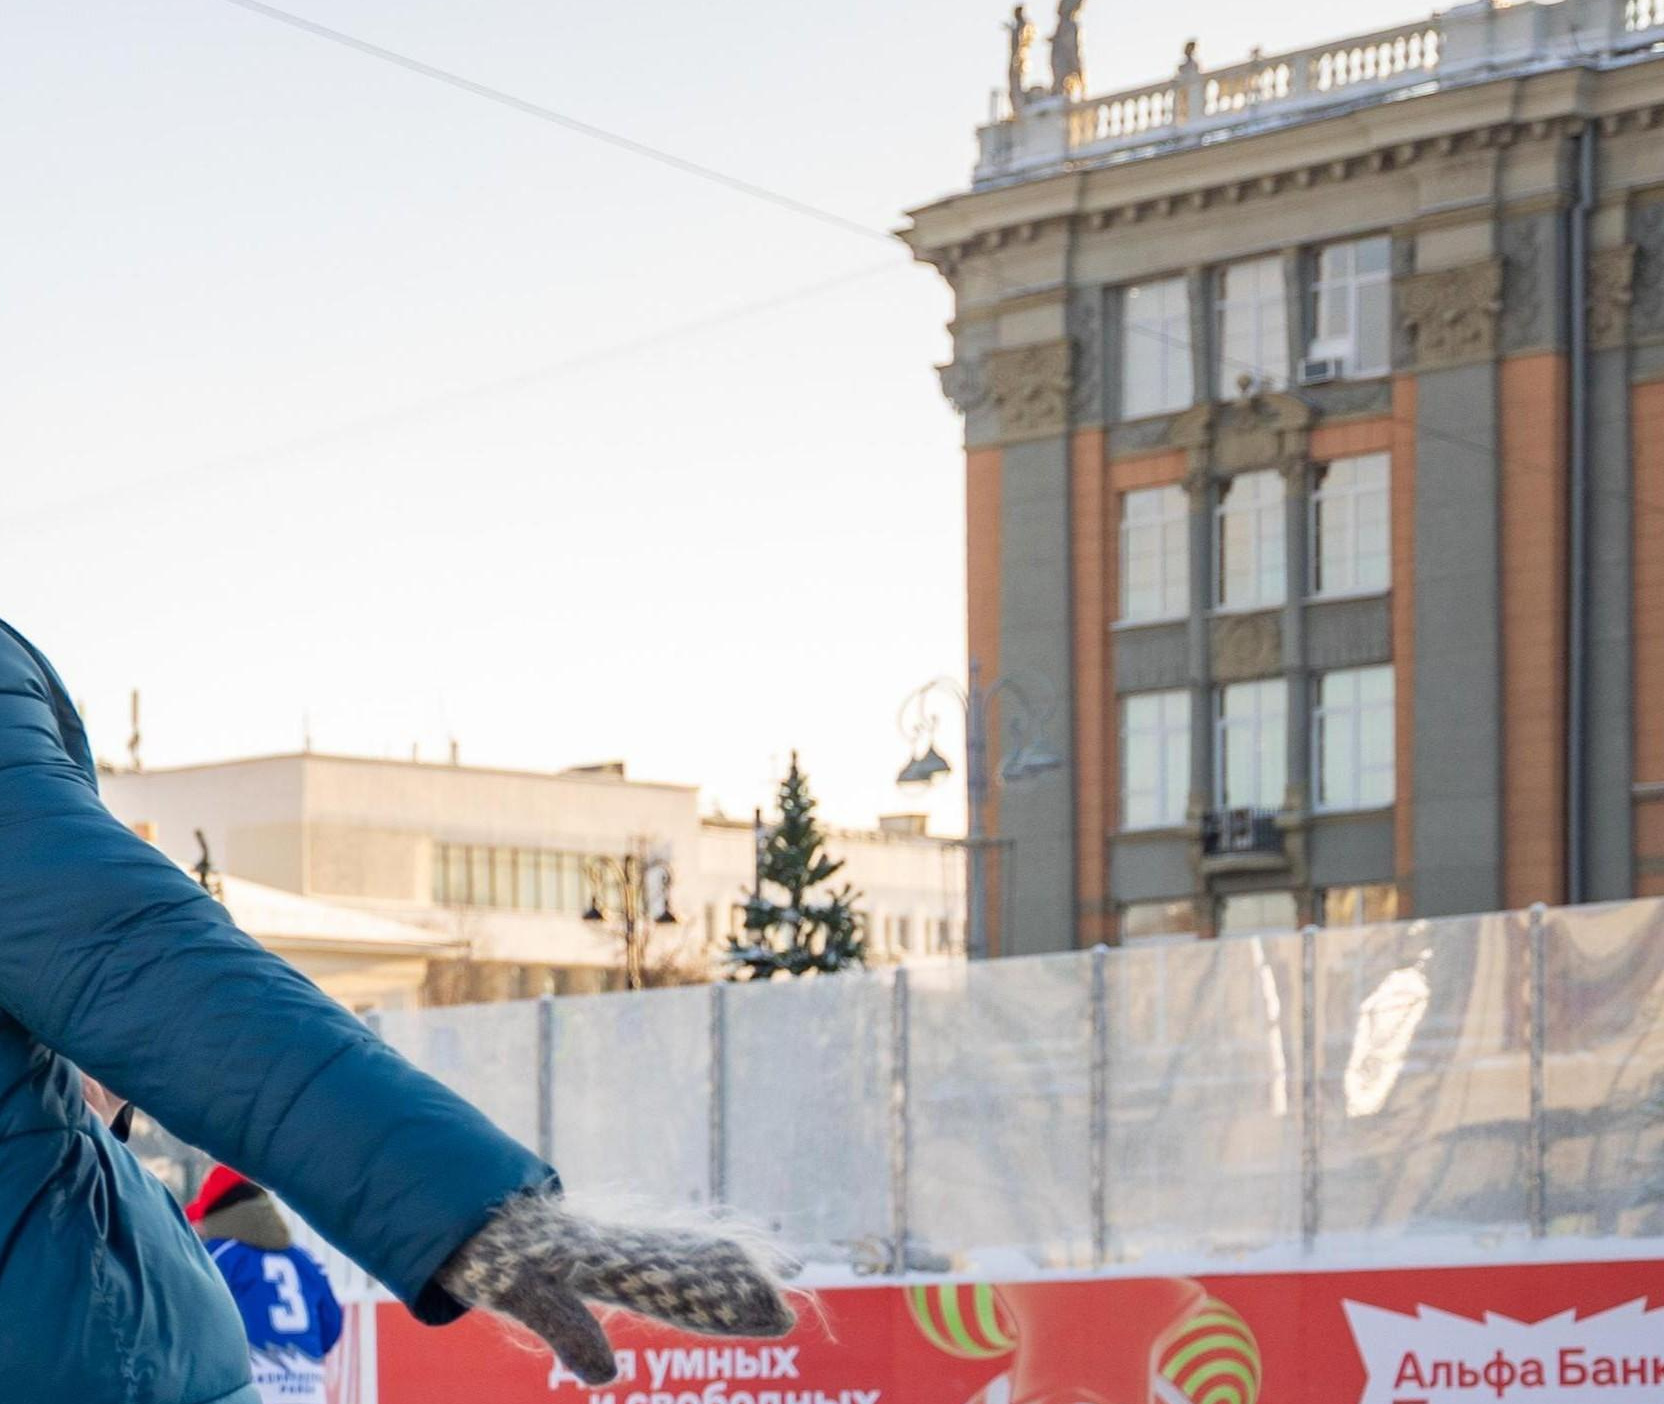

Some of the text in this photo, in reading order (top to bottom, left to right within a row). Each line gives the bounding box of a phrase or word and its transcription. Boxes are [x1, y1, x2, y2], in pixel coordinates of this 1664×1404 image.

[261, 1253, 310, 1334] 3
[644, 1346, 800, 1389] умных
[1393, 1348, 1546, 1399] Альфа
